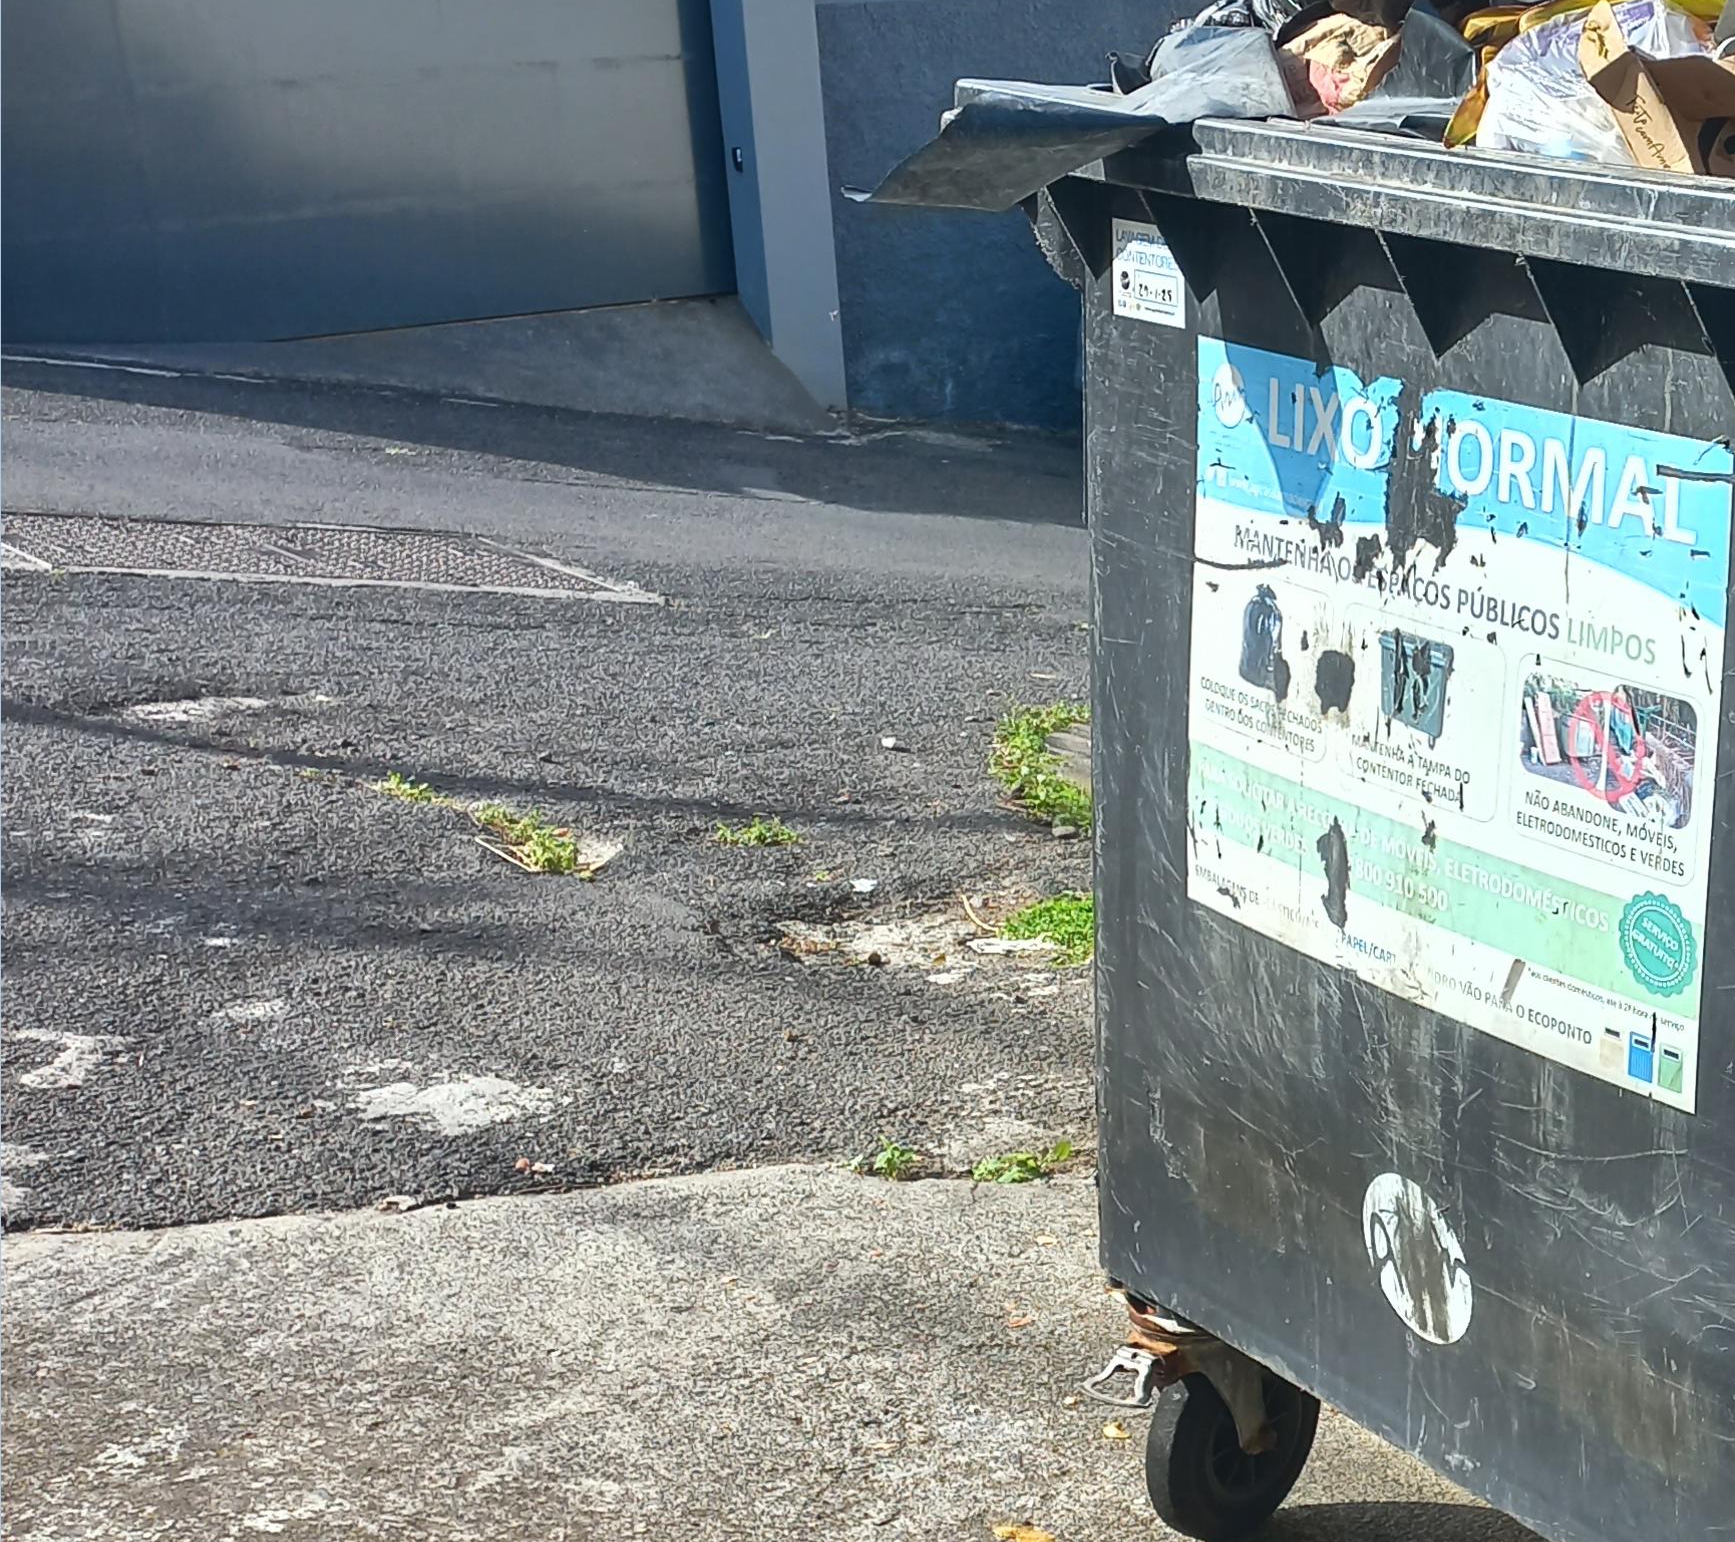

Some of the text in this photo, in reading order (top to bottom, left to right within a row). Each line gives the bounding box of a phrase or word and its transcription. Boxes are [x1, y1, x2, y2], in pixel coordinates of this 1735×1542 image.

[1269, 377, 1382, 470] LIXO
[1234, 524, 1333, 577] MANTENHA
[1337, 556, 1364, 584] O
[1457, 586, 1560, 640] PÚBLICOS
[1567, 618, 1656, 665] LIMPOS
[1200, 676, 1236, 701] COLOQUE
[1238, 691, 1249, 706] OS
[1356, 757, 1413, 787] CONTENTOR
[1417, 756, 1452, 779] TAMPA
[1454, 768, 1471, 785] DO
[1525, 789, 1678, 854] NÃO ABANDONE, MÓVEIS,
[1356, 859, 1383, 885] 800
[1385, 869, 1414, 899] 910
[1630, 847, 1637, 862] E
[1640, 849, 1685, 877] VERDES
[1445, 858, 1610, 932] ELETRODOMÉSTICOS
[1641, 916, 1679, 951] SERVIÇO
[1458, 980, 1482, 1001] VÃO
[1516, 1004, 1525, 1018] O
[1528, 1008, 1592, 1044] ECOPONTO
